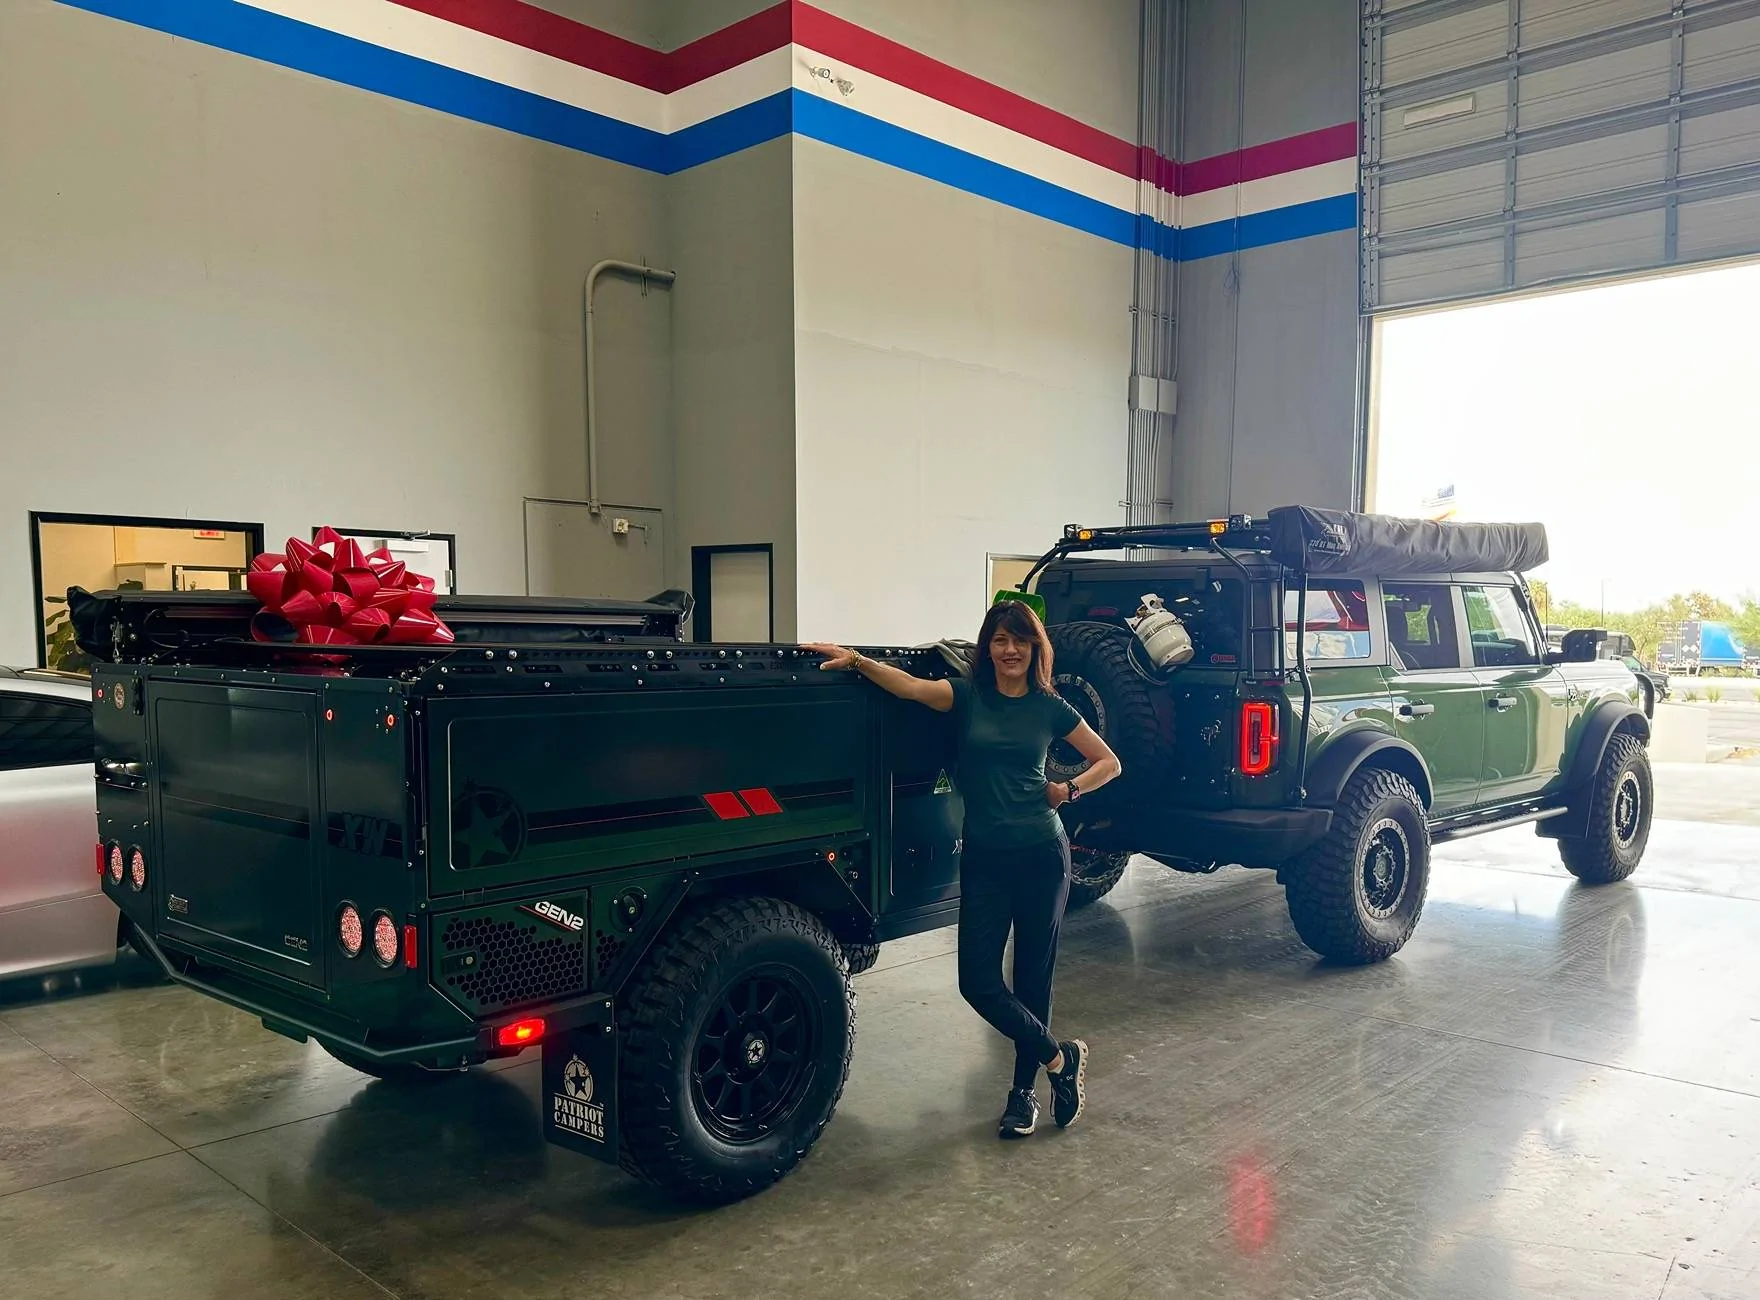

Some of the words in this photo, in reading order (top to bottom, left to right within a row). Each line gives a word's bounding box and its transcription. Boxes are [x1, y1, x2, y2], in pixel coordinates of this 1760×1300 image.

[534, 900, 584, 930] GEN2
[554, 1096, 604, 1126] PATRIOT
[554, 1111, 604, 1138] CAMPERS
